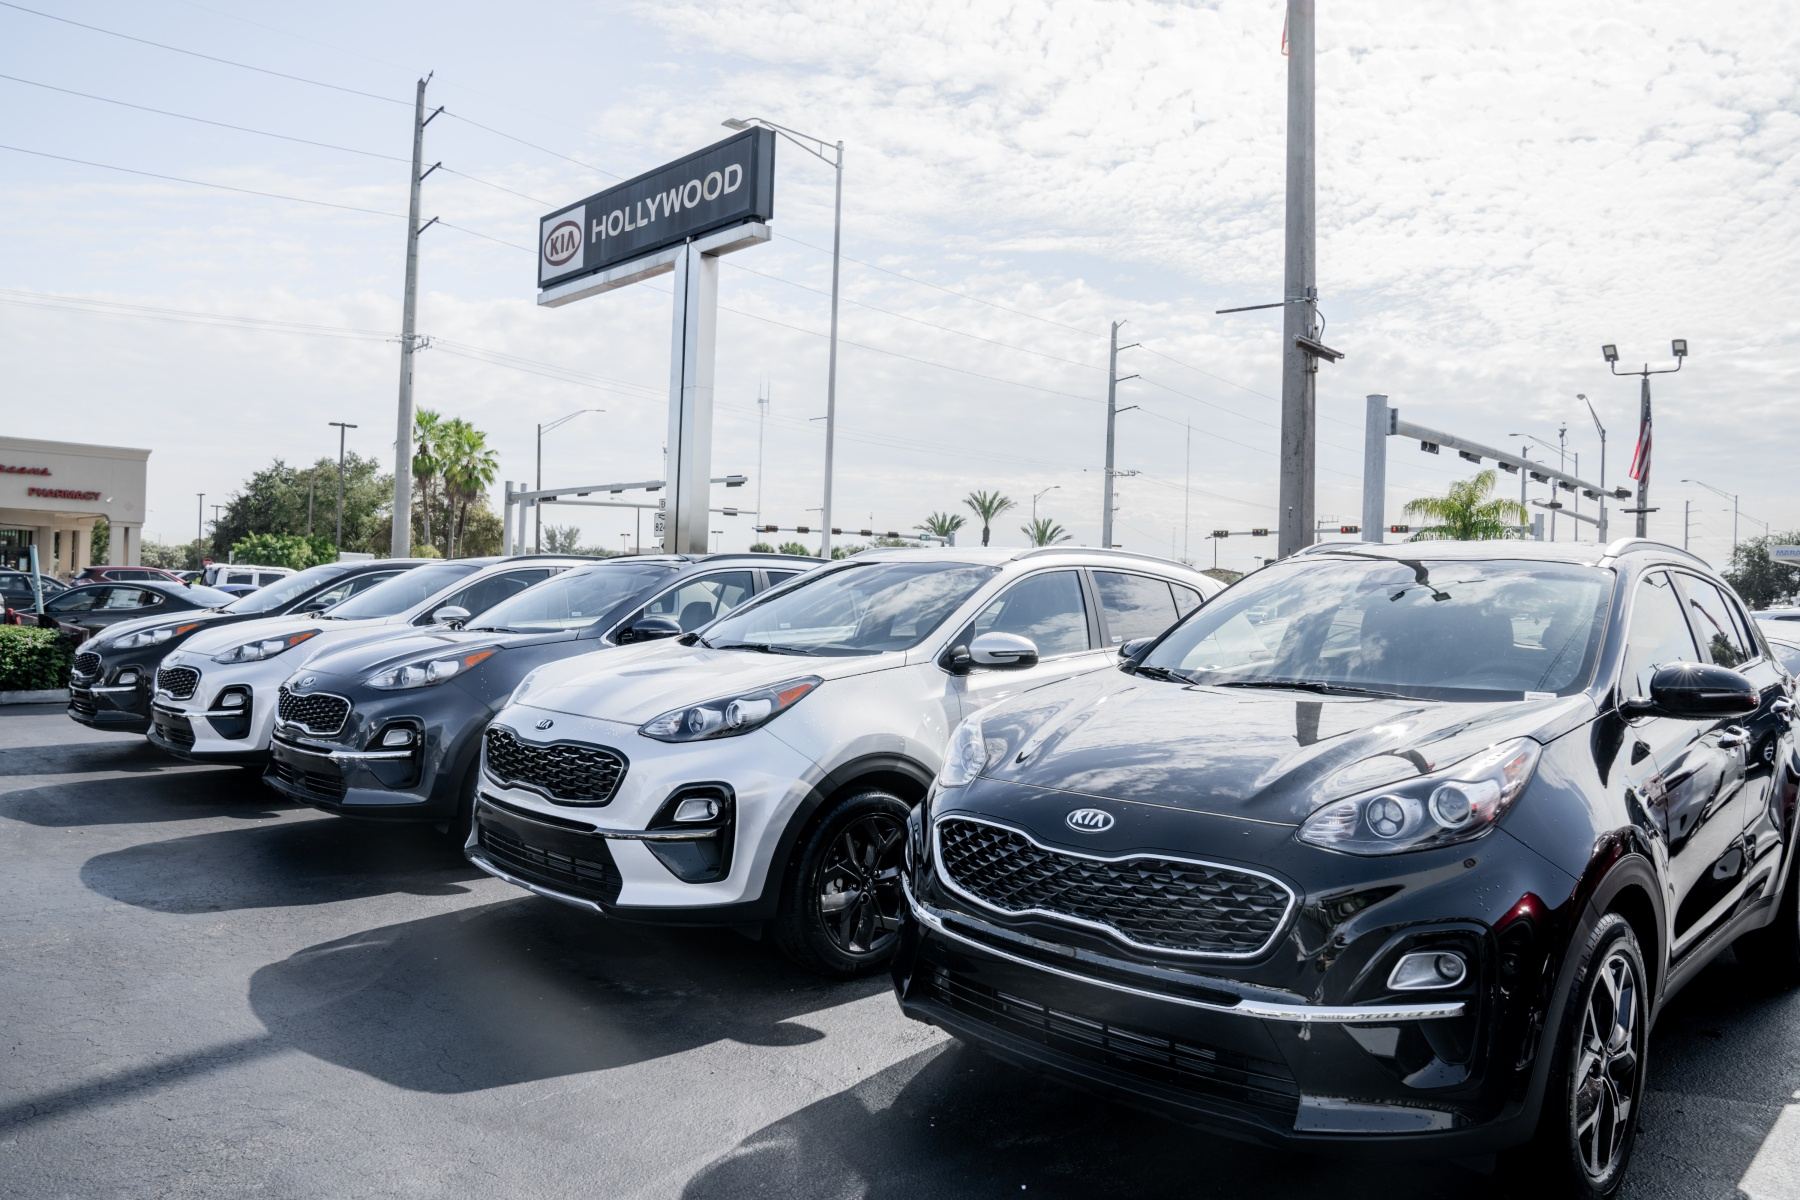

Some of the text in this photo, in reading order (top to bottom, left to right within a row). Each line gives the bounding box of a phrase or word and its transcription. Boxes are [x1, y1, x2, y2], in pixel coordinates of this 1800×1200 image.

[549, 163, 743, 258] KIA HOLLYWOOD
[27, 487, 102, 501] PHARMACY
[1071, 810, 1105, 828] KIA
